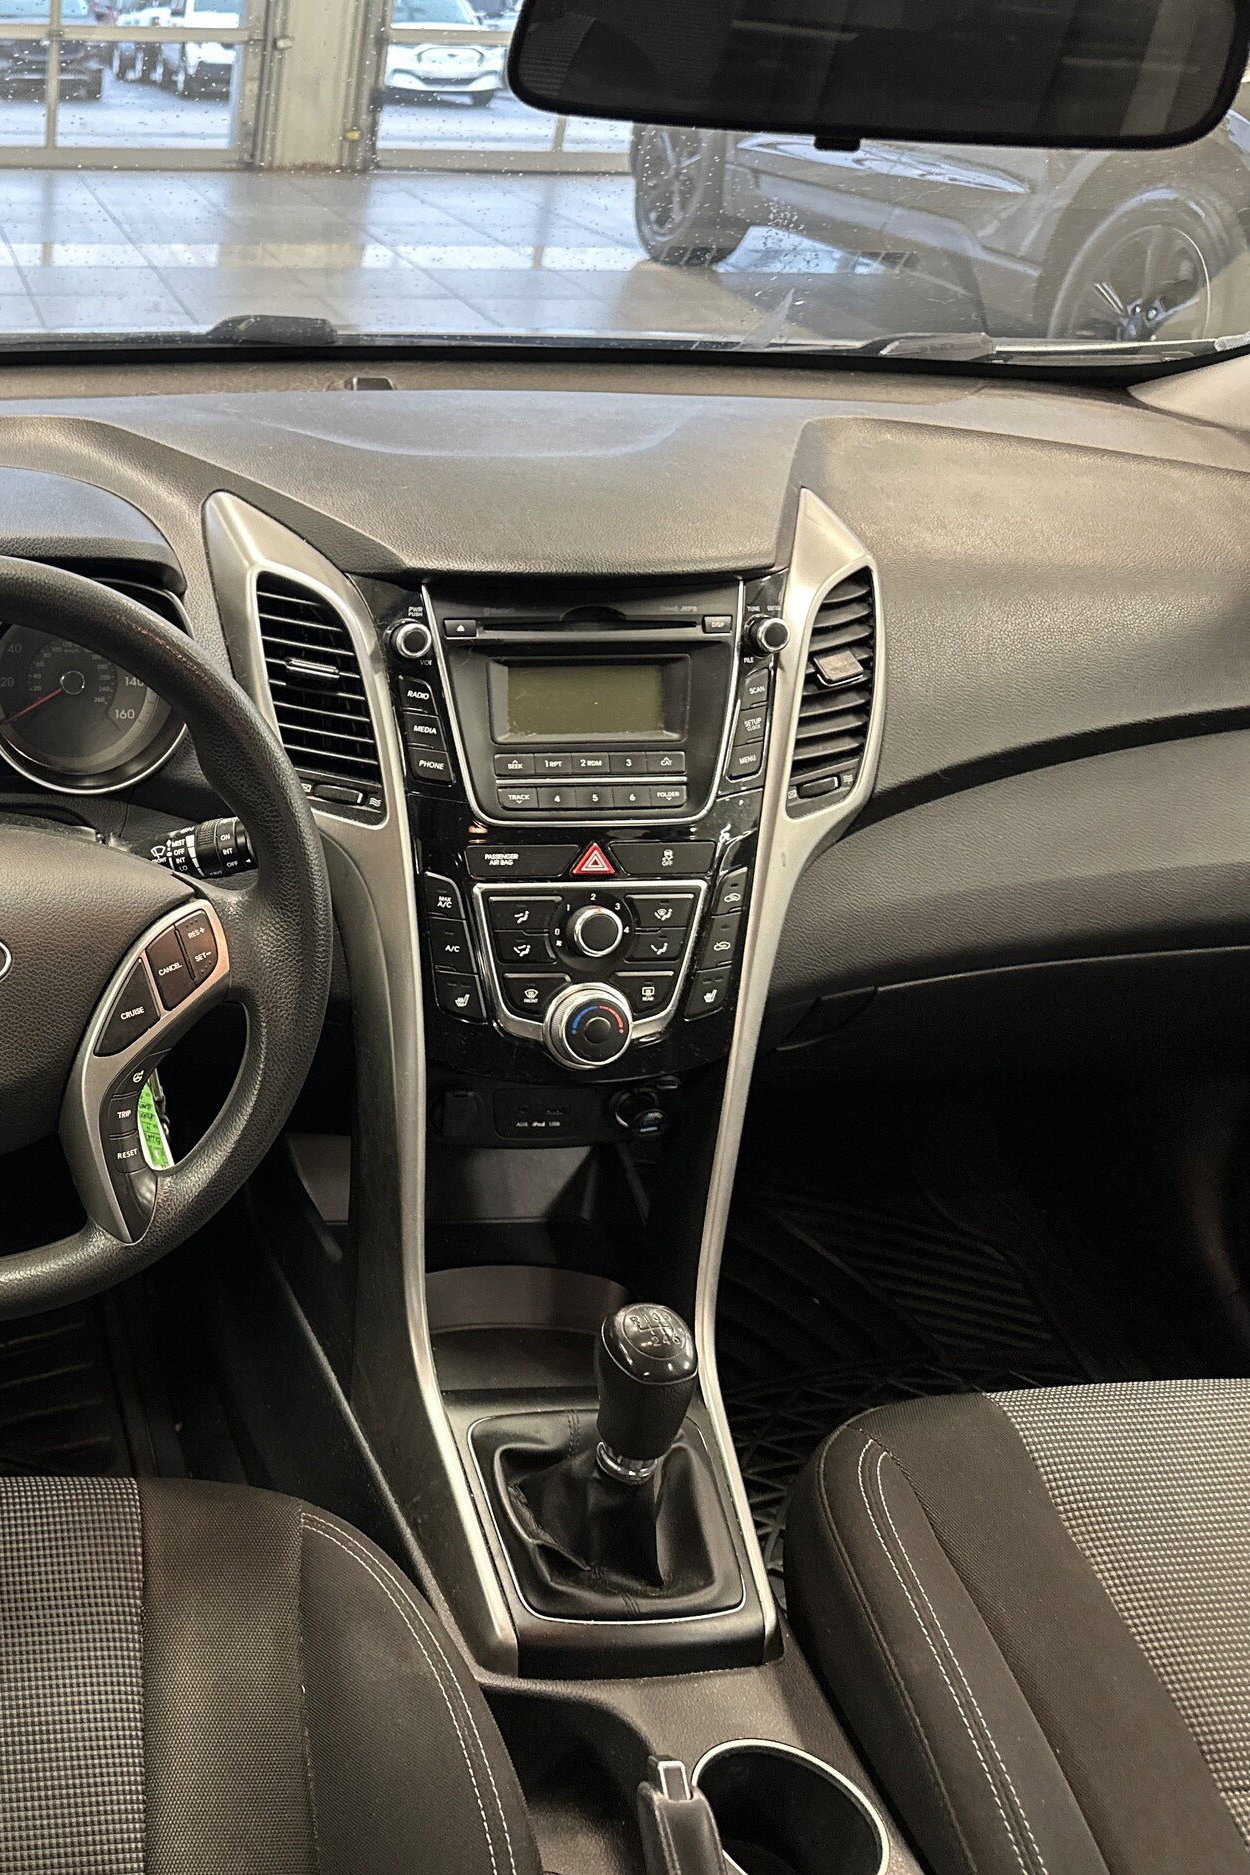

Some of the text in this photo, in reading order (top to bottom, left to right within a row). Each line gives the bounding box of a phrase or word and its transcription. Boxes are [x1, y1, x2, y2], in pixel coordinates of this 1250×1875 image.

[7, 643, 22, 654] 40
[0, 676, 15, 687] 20
[124, 676, 145, 687] 140
[749, 685, 765, 695] SCAN
[407, 690, 430, 700] RADIO
[114, 709, 135, 720] 160
[744, 717, 762, 727] SETUP
[413, 725, 437, 735] MEDIA
[746, 724, 761, 732] CLOCK
[580, 759, 586, 767] 2
[625, 758, 632, 767] 3
[738, 754, 756, 764] MENU
[418, 759, 445, 770] PHONE
[553, 794, 561, 803] 4
[592, 794, 599, 802] 5
[629, 793, 636, 802] 6
[220, 833, 231, 841] ON
[172, 839, 185, 847] MIST
[173, 848, 185, 856] OFF
[614, 902, 621, 910] 3
[623, 926, 630, 934] 4
[445, 944, 460, 952] A/C
[158, 962, 183, 976] CANCEL
[120, 1006, 145, 1020] CRUISE
[117, 1110, 131, 1119] TRIP
[117, 1148, 138, 1159] RESET
